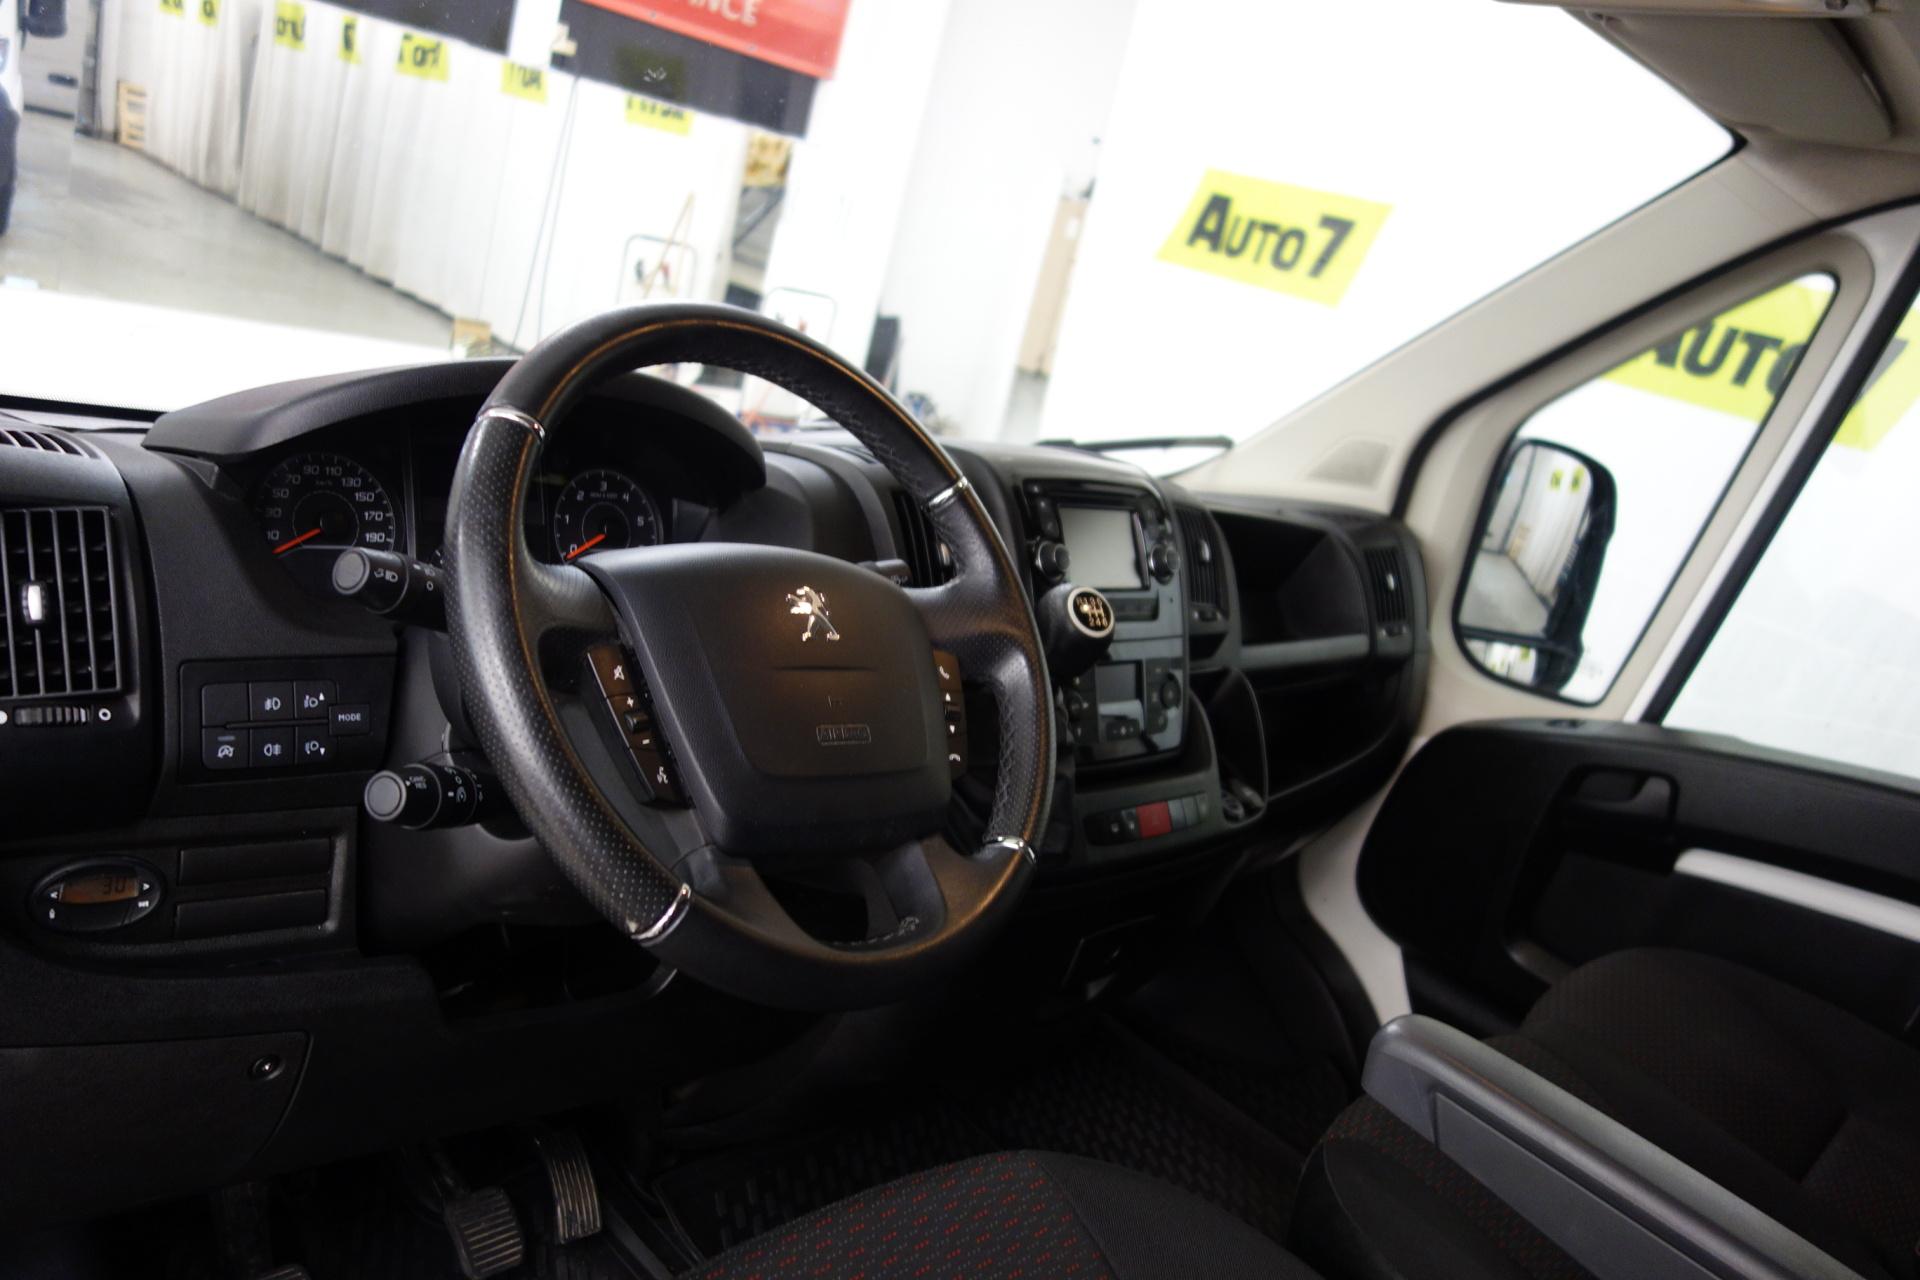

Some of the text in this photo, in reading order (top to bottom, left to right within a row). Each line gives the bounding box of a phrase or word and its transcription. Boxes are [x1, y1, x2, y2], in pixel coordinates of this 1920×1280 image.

[1308, 213, 1355, 279] 7
[325, 466, 342, 477] 110
[341, 477, 362, 488] 130
[272, 487, 289, 499] 50
[354, 491, 375, 503] 150
[364, 511, 384, 521] 170
[266, 530, 280, 541] 10
[364, 532, 386, 543] 190
[337, 712, 361, 722] MODE
